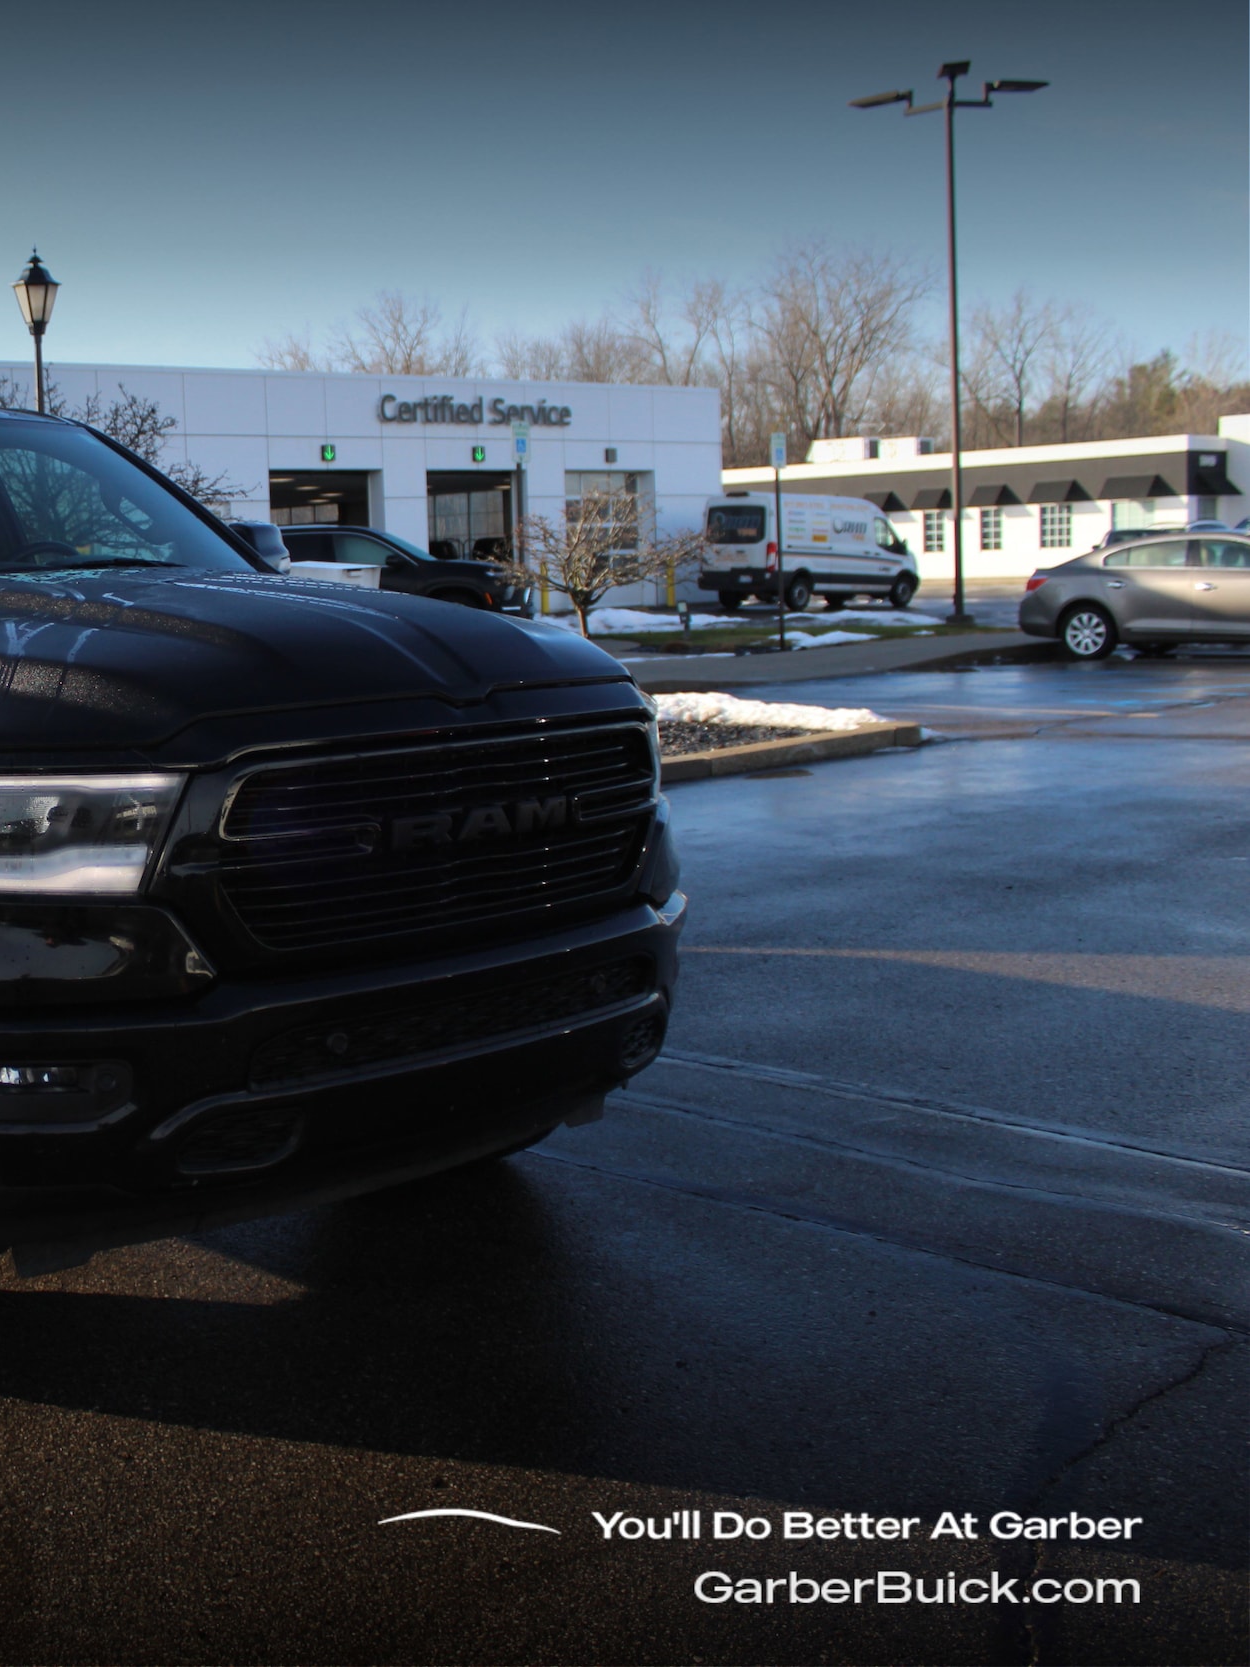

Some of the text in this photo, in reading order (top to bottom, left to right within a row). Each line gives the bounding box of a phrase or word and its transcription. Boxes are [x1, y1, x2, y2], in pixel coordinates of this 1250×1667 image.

[379, 394, 572, 426] Certified Service
[392, 795, 568, 850] RAM
